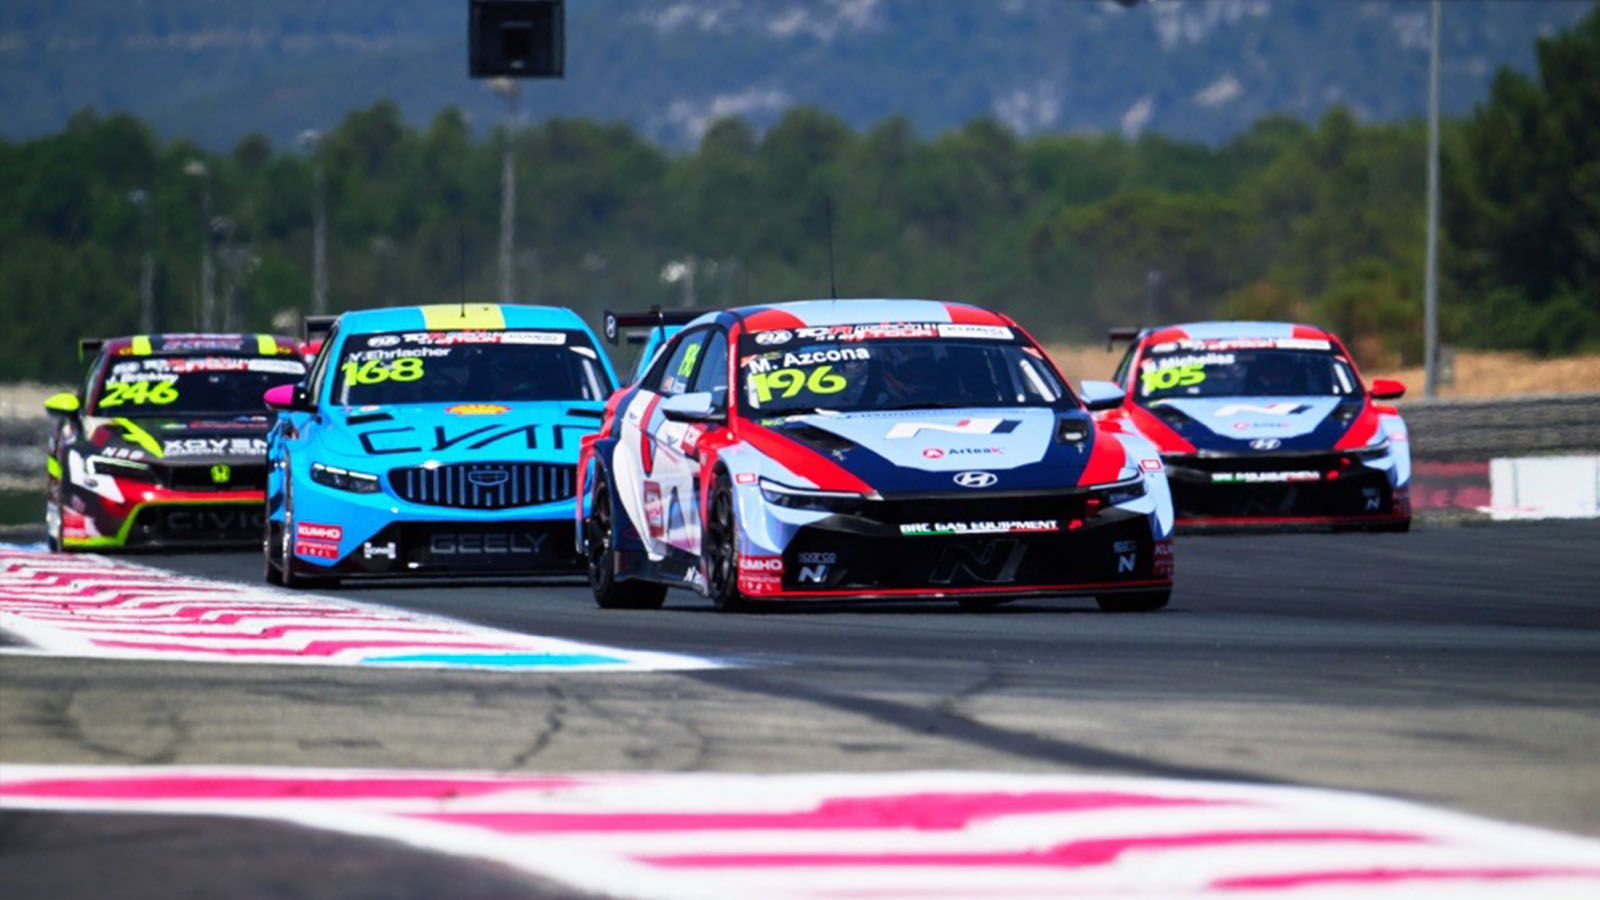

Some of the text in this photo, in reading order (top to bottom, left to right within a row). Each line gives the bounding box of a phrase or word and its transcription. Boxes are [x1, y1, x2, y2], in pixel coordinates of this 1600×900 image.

[341, 357, 424, 386] 168
[748, 347, 870, 373] M. Azcona
[750, 365, 847, 402] 196
[1141, 365, 1206, 392] 105
[99, 381, 179, 408] 246
[934, 520, 968, 532] GAS
[969, 519, 1058, 531] EQUIPMENT
[429, 533, 550, 553] GEELY
